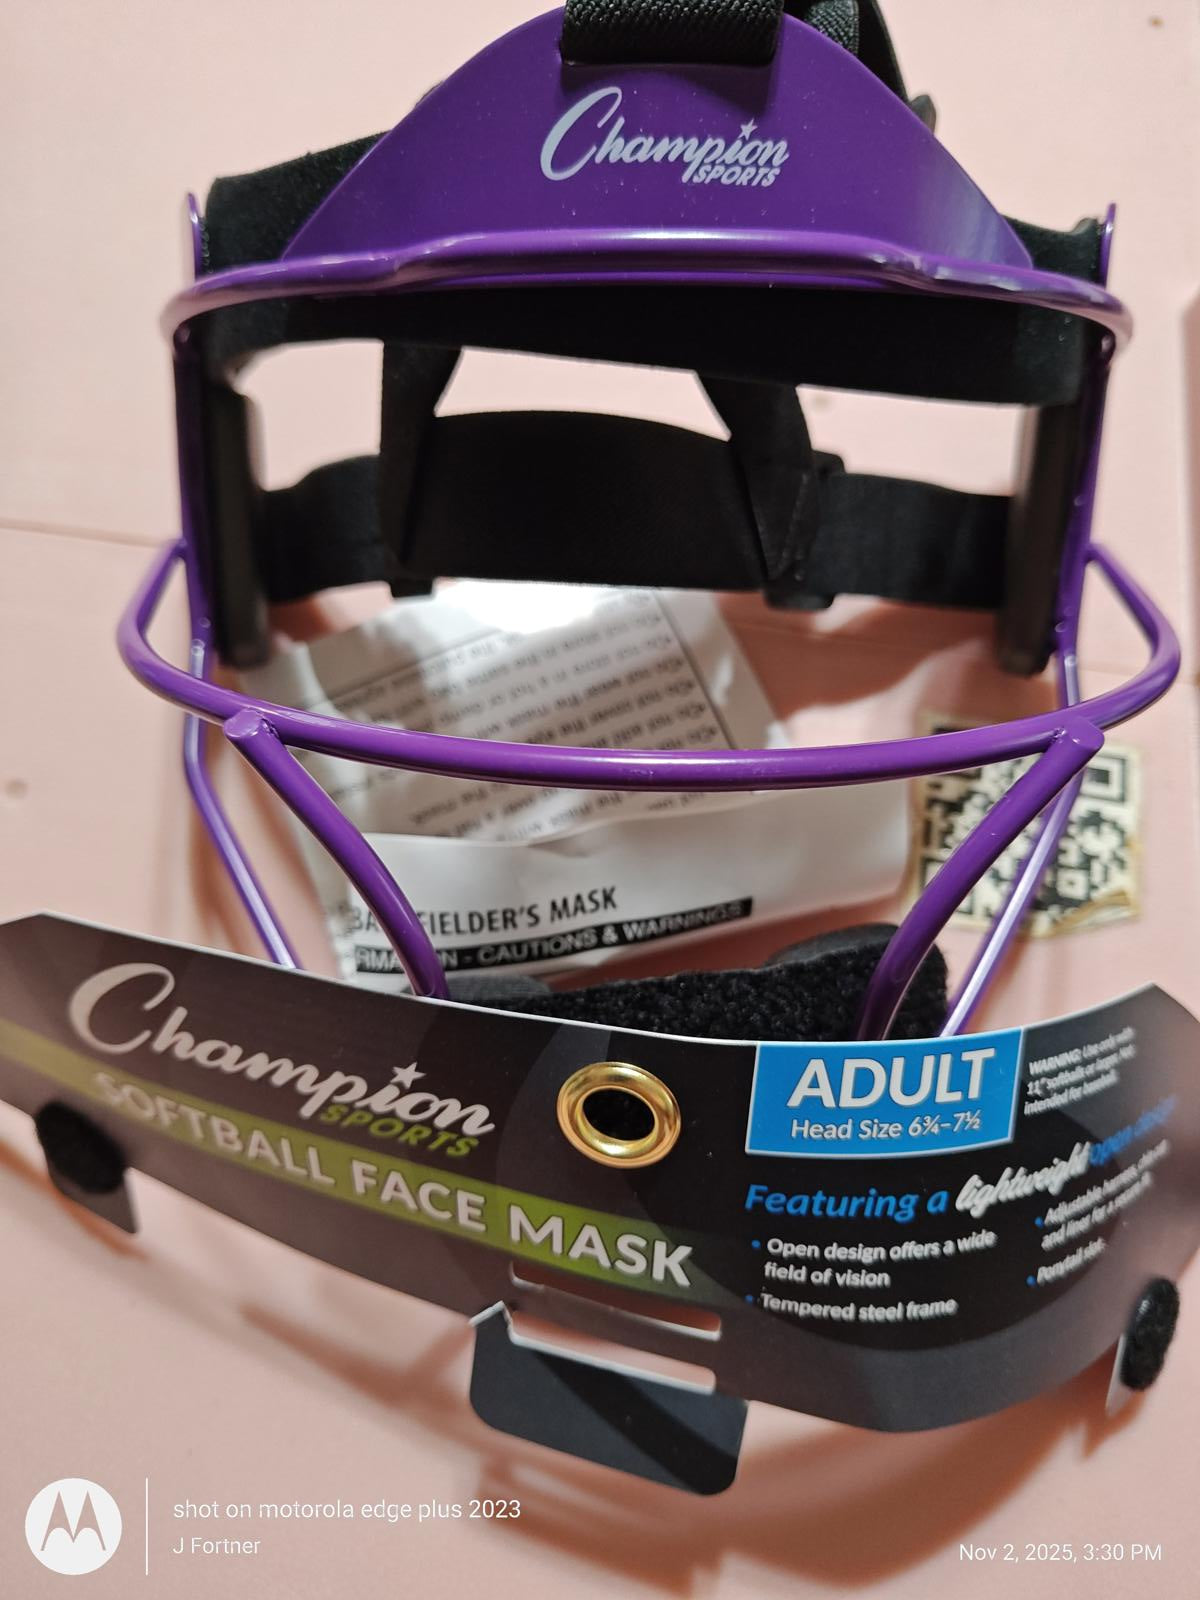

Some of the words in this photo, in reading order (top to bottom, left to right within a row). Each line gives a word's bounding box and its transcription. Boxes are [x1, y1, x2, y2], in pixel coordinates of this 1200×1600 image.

[540, 86, 790, 183] Champion
[693, 165, 781, 187] SPORTS
[551, 886, 618, 923] MASK
[477, 929, 598, 964] CAUTIONS
[602, 925, 619, 944] &
[623, 902, 742, 941] WARNINGS
[68, 963, 495, 1136] Champion
[786, 1048, 996, 1109] ADULT
[321, 1105, 480, 1158] SPORTS
[791, 1119, 850, 1140] Head
[858, 1118, 903, 1140] Size
[92, 1071, 335, 1186] SOFTBALL
[350, 1159, 488, 1233] FACE
[509, 1204, 693, 1288] MASK
[745, 1184, 920, 1223] Featuring
[927, 1190, 949, 1214] a
[955, 1141, 1091, 1219] lightweight
[767, 1237, 820, 1260] Open
[824, 1242, 887, 1265] design
[889, 1240, 941, 1261] offers
[943, 1240, 956, 1255] a
[957, 1229, 998, 1252] wide
[764, 1261, 807, 1284] field
[810, 1268, 833, 1285] of
[836, 1269, 891, 1288] vision
[761, 1292, 855, 1320] Tempered
[858, 1302, 904, 1321] steel
[906, 1298, 959, 1319] frame
